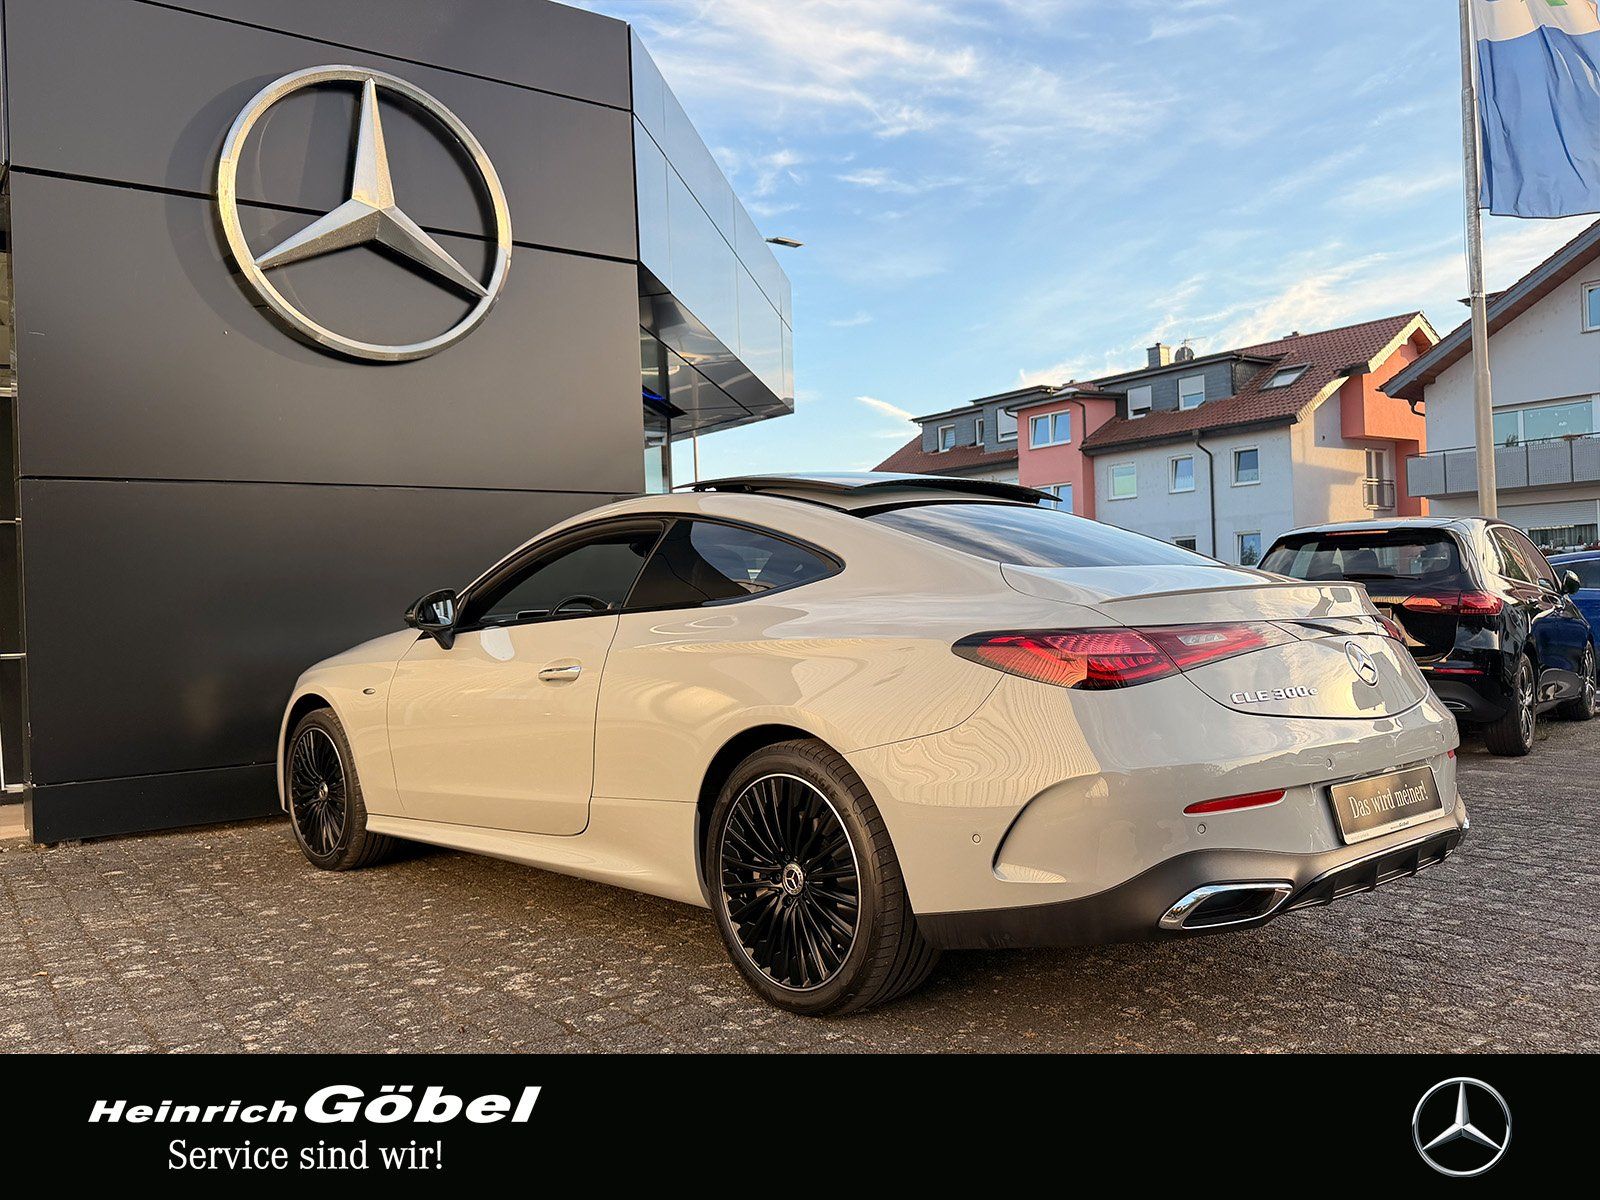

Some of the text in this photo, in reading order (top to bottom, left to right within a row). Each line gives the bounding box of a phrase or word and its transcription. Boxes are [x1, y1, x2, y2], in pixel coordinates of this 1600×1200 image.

[1230, 685, 1319, 705] CLE 300e
[1348, 780, 1429, 819] Das wird meiner!
